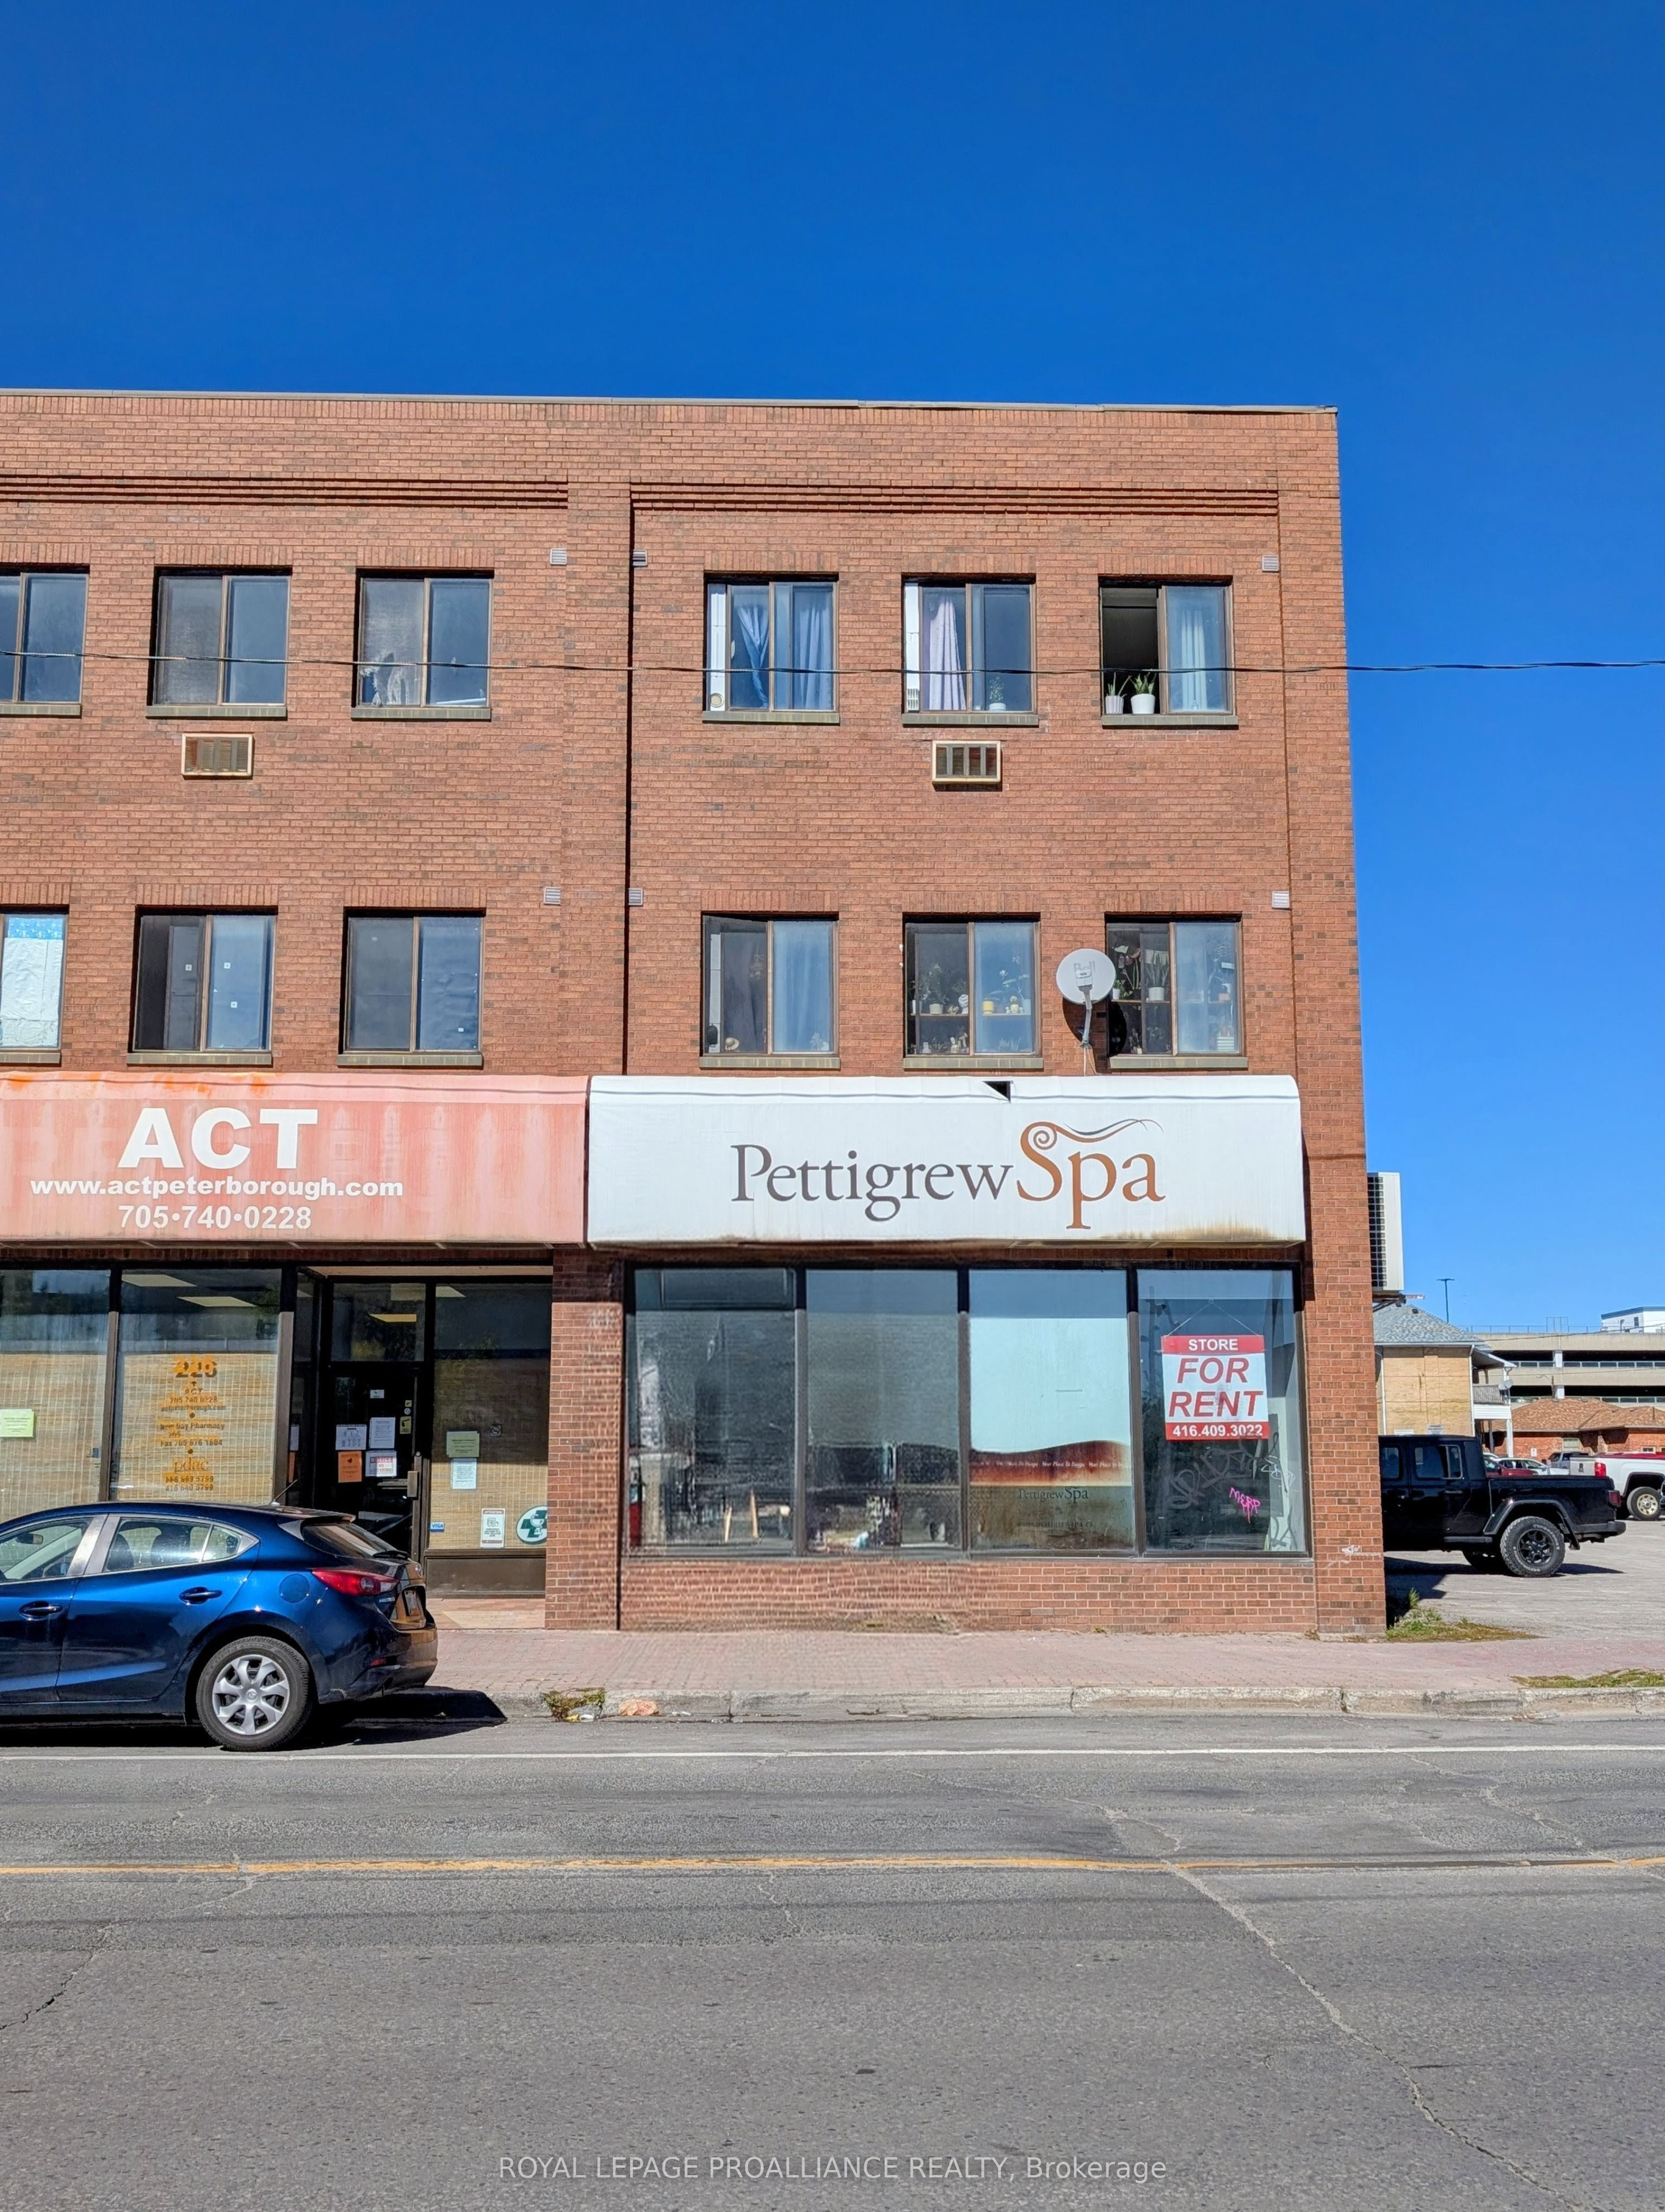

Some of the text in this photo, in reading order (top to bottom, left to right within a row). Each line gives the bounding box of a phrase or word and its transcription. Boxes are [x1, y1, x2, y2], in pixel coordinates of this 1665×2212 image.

[118, 1107, 318, 1169] ACT
[30, 1176, 403, 1201] www.actpeterborough.com
[1188, 1339, 1238, 1351] STORE
[174, 1355, 218, 1377] 226
[1177, 1357, 1250, 1384] FOR
[1168, 1390, 1264, 1418] RENT
[1173, 1424, 1264, 1438] 416.409.3022
